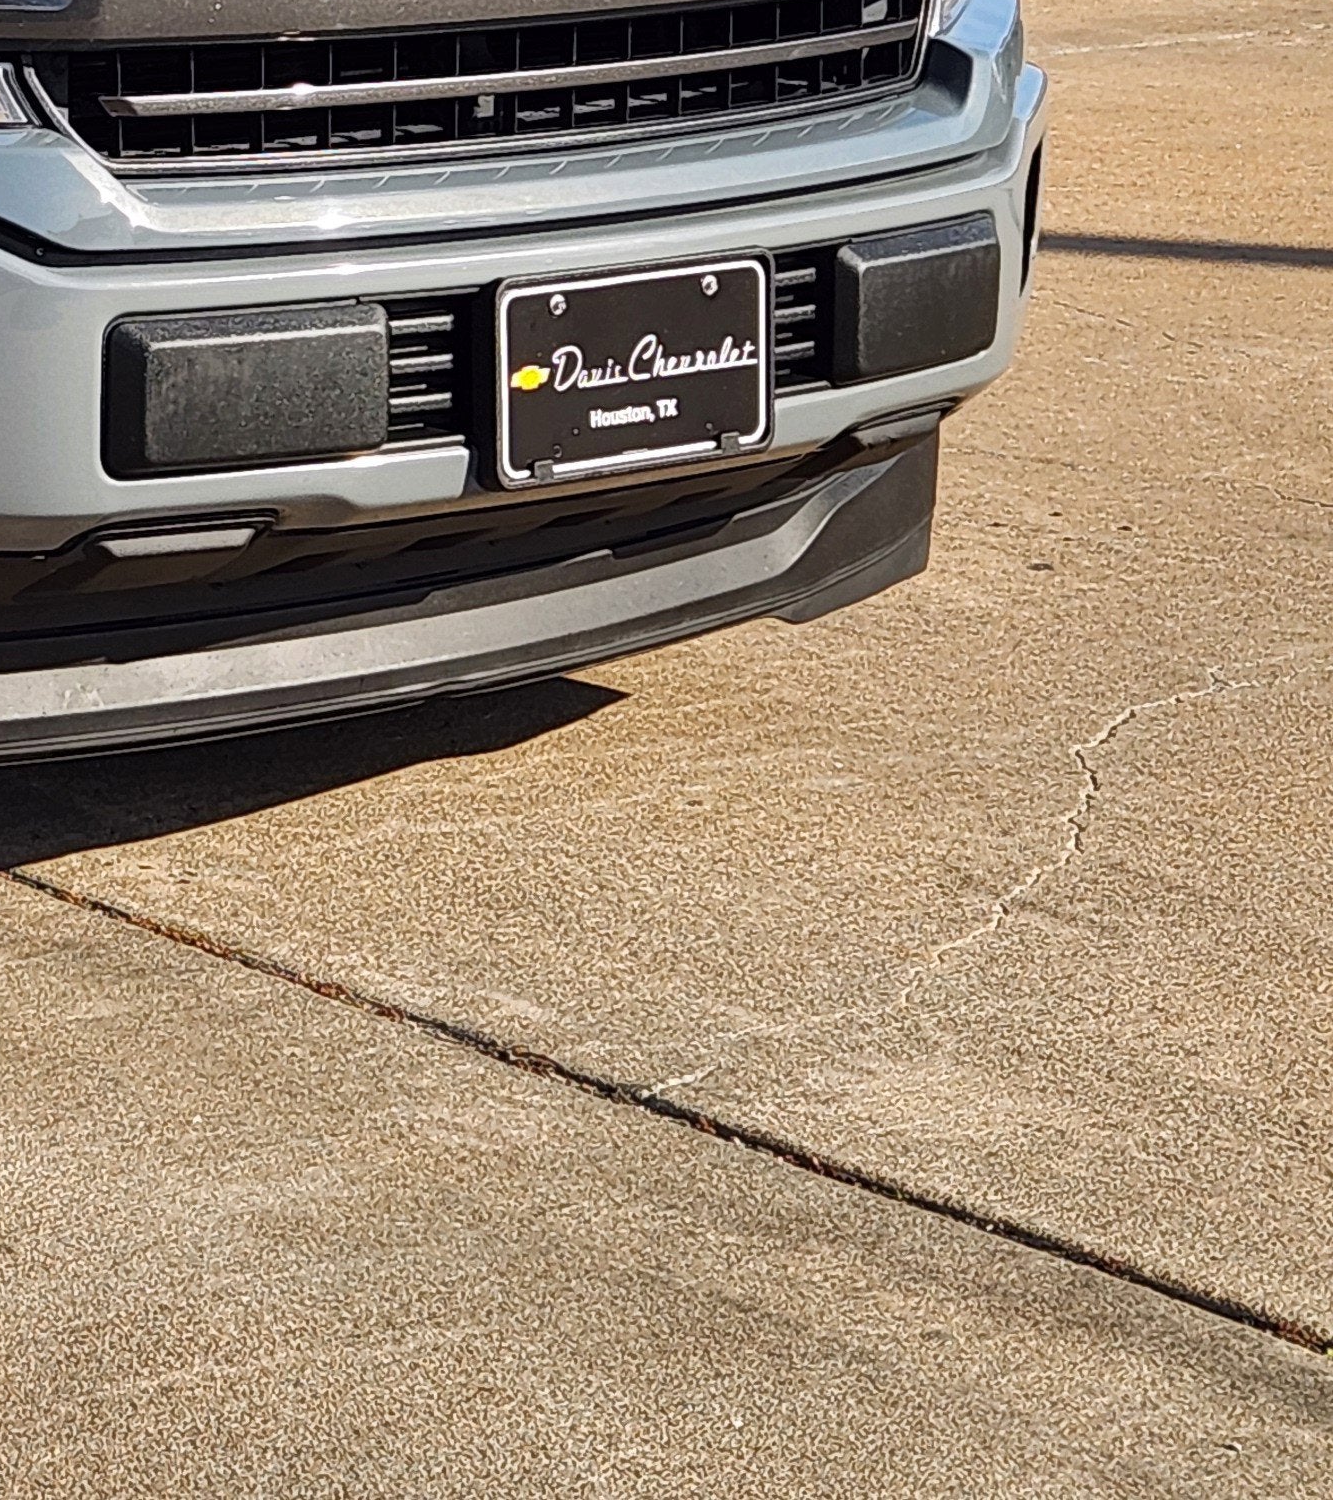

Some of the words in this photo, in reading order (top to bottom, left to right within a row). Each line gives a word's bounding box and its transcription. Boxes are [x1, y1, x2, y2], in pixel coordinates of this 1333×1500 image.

[552, 344, 629, 392] Davis
[627, 333, 758, 382] Chevrolet
[589, 403, 655, 428] Houston,
[656, 398, 679, 418] TX
